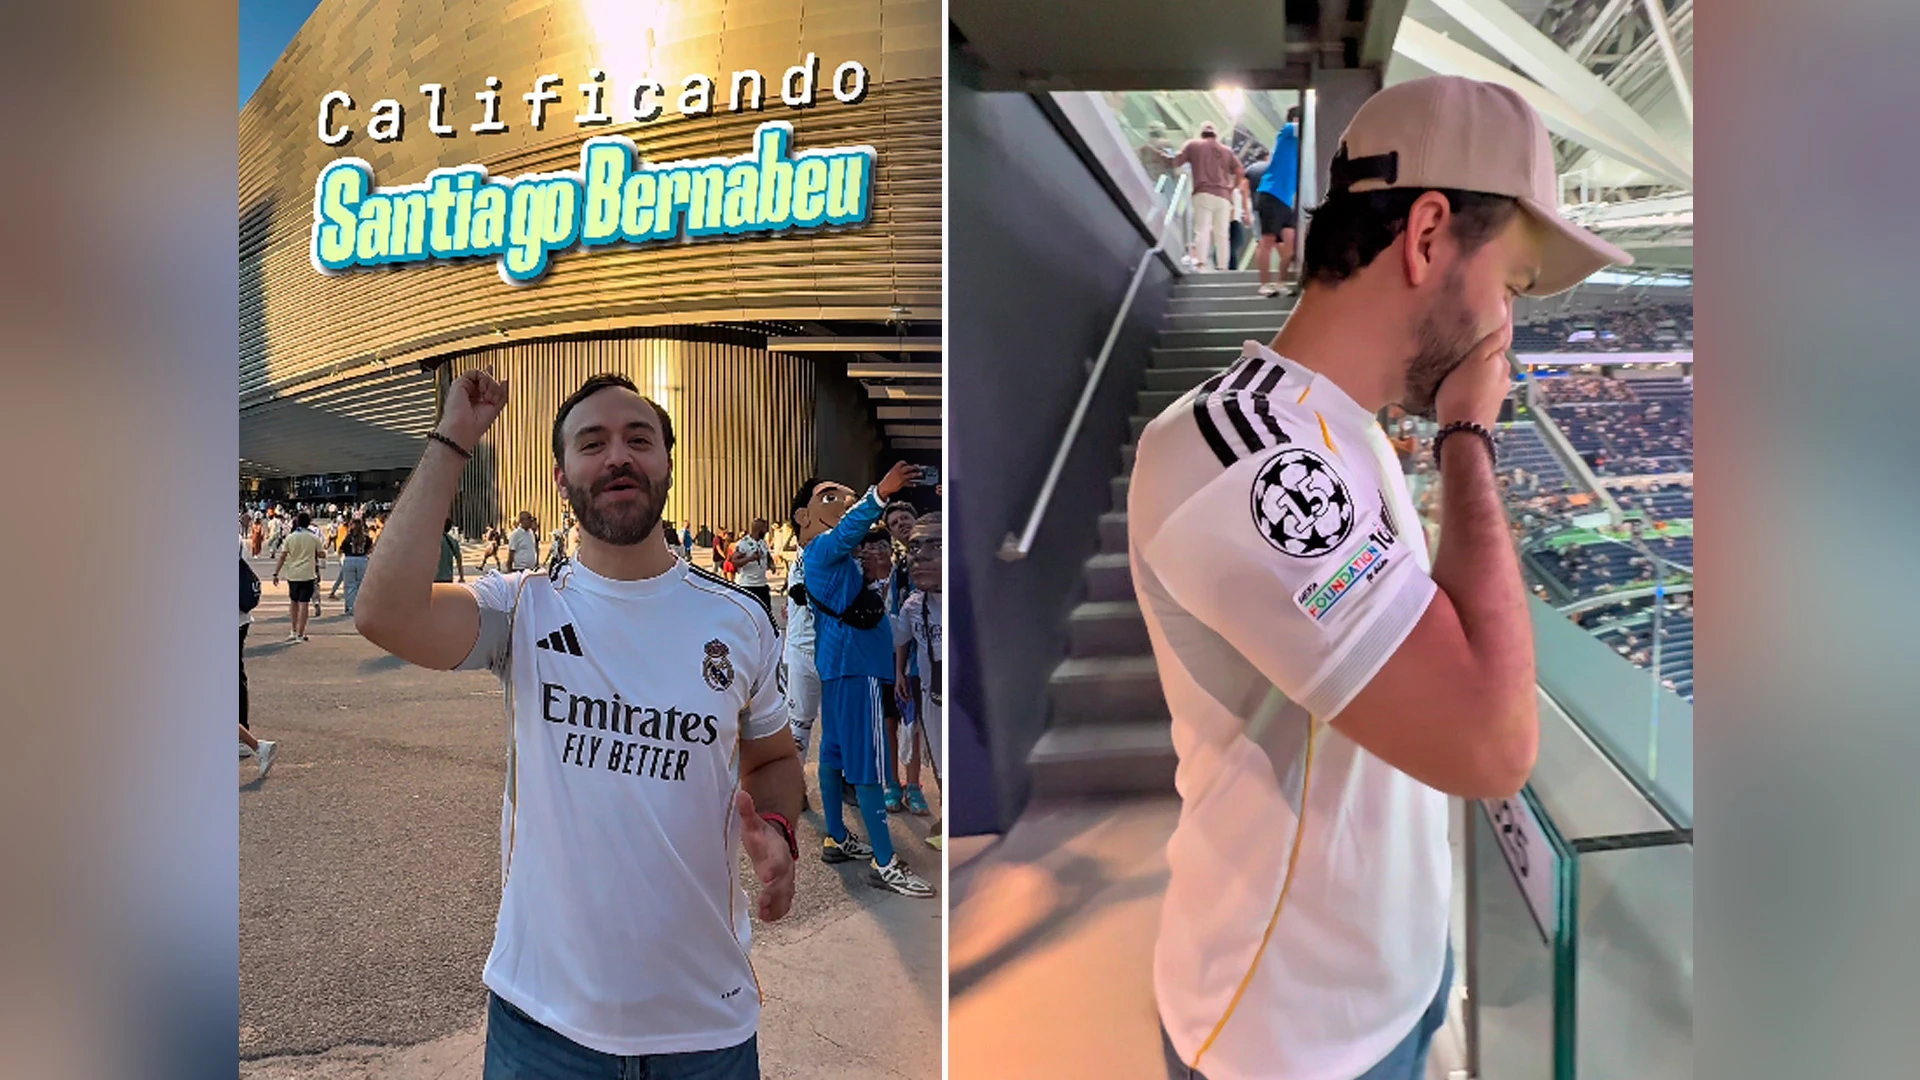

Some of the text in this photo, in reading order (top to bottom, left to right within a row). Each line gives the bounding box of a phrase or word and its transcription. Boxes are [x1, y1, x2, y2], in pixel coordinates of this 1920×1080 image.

[1276, 475, 1331, 534] 15
[1309, 546, 1379, 618] FOUNDATION
[541, 682, 718, 745] Emirates
[562, 732, 690, 781] FLY BETTER
